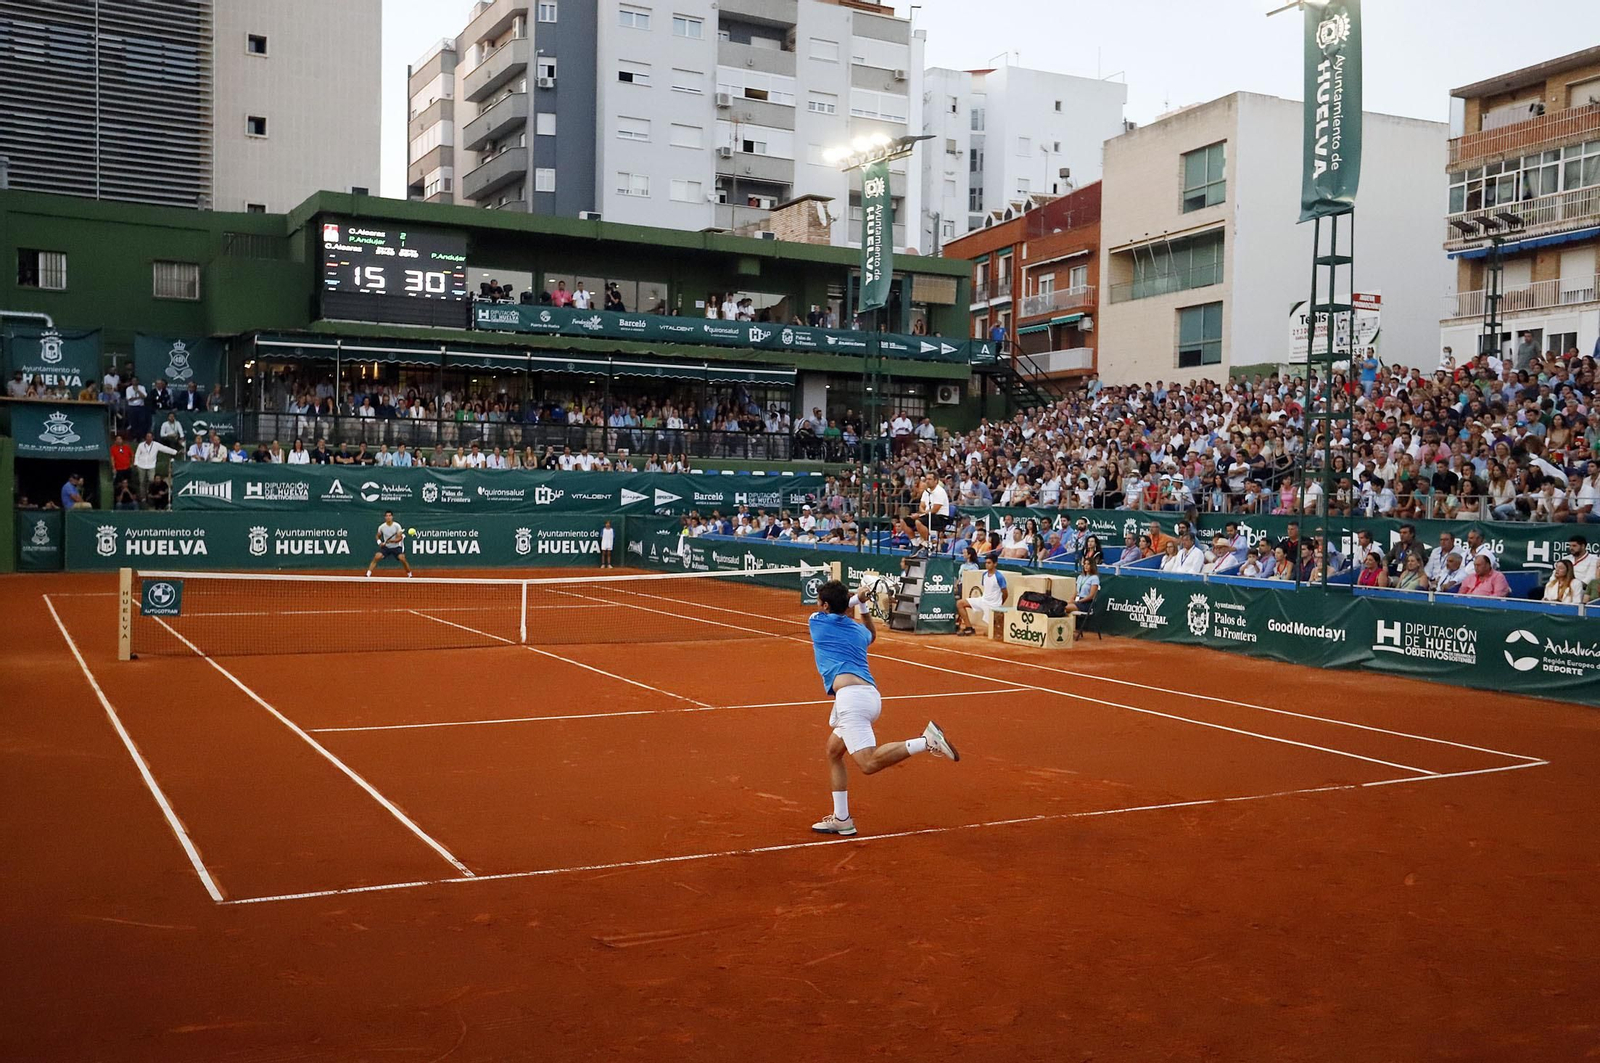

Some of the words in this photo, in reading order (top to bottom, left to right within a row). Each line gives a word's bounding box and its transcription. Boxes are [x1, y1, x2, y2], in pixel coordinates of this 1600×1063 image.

[1331, 54, 1346, 150] Ayuntamiento
[1312, 60, 1331, 180] HUELVA
[1331, 152, 1342, 171] de
[874, 204, 884, 268] Ayuntamiento
[865, 206, 874, 286] HUELVA
[354, 266, 386, 288] 15
[404, 270, 446, 293] 30
[874, 269, 882, 280] de
[619, 318, 646, 328] Barceló
[658, 324, 694, 332] VITALDENT
[22, 365, 67, 374] Ayuntamiento
[264, 482, 310, 490] DIPUTACIÓN
[694, 492, 724, 500] Barceló
[125, 528, 192, 538] Ayuntamiento
[193, 528, 205, 537] de
[275, 528, 334, 538] Ayuntamiento
[337, 528, 348, 537] de
[468, 529, 479, 537] de
[538, 530, 586, 539] Ayuntamiento
[126, 540, 208, 555] HUELVA
[276, 540, 350, 554] HUELVA
[412, 540, 480, 554] HUELVA
[538, 540, 601, 554] HUELVA
[1454, 538, 1504, 554] Baeló
[1527, 541, 1550, 562] H
[924, 580, 953, 593] Seabery
[1106, 598, 1147, 616] Fundación
[1214, 601, 1245, 611] Ayuntamiento
[1130, 613, 1145, 622] CAJA
[1146, 614, 1168, 625] RURAL
[1215, 612, 1234, 625] Palos
[1237, 615, 1246, 626] de
[1010, 622, 1046, 647] Seabery
[1214, 627, 1222, 637] la
[1223, 629, 1257, 642] Frontera
[1377, 620, 1401, 646] H
[1405, 622, 1477, 642] DIPUTACIÓN
[1405, 635, 1420, 647] DE
[1426, 638, 1476, 654] HUELVA
[1544, 637, 1600, 657] Andalucía
[1405, 647, 1449, 660] OBJETIVOS
[1543, 657, 1565, 665] Región
[1567, 660, 1595, 669] Europea
[1543, 664, 1583, 676] DEPORTE
